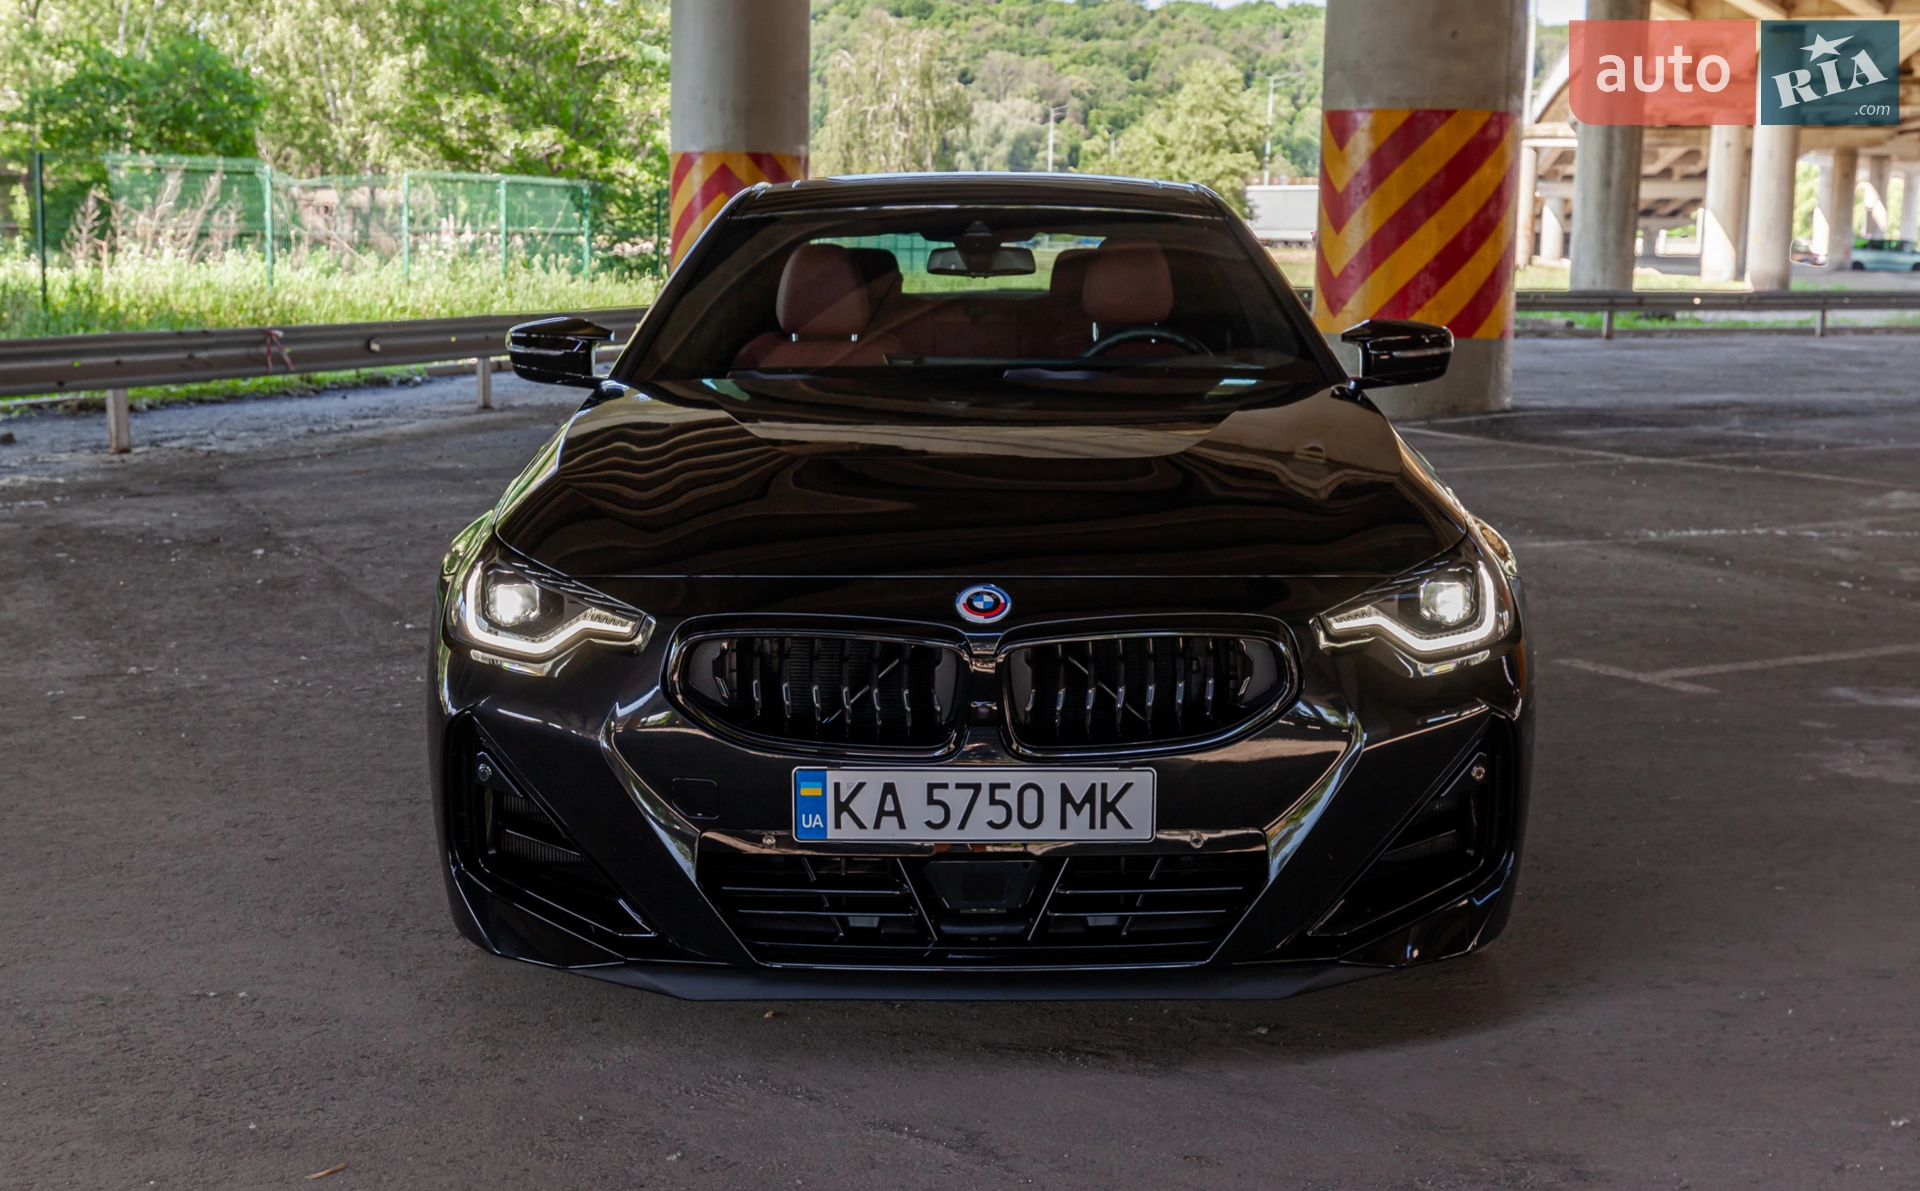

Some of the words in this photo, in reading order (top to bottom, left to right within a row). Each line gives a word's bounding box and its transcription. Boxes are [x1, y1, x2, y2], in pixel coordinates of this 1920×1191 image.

[802, 814, 823, 828] UA
[833, 782, 907, 830] KA
[924, 782, 1044, 830] 5750
[1059, 782, 1135, 830] MK
